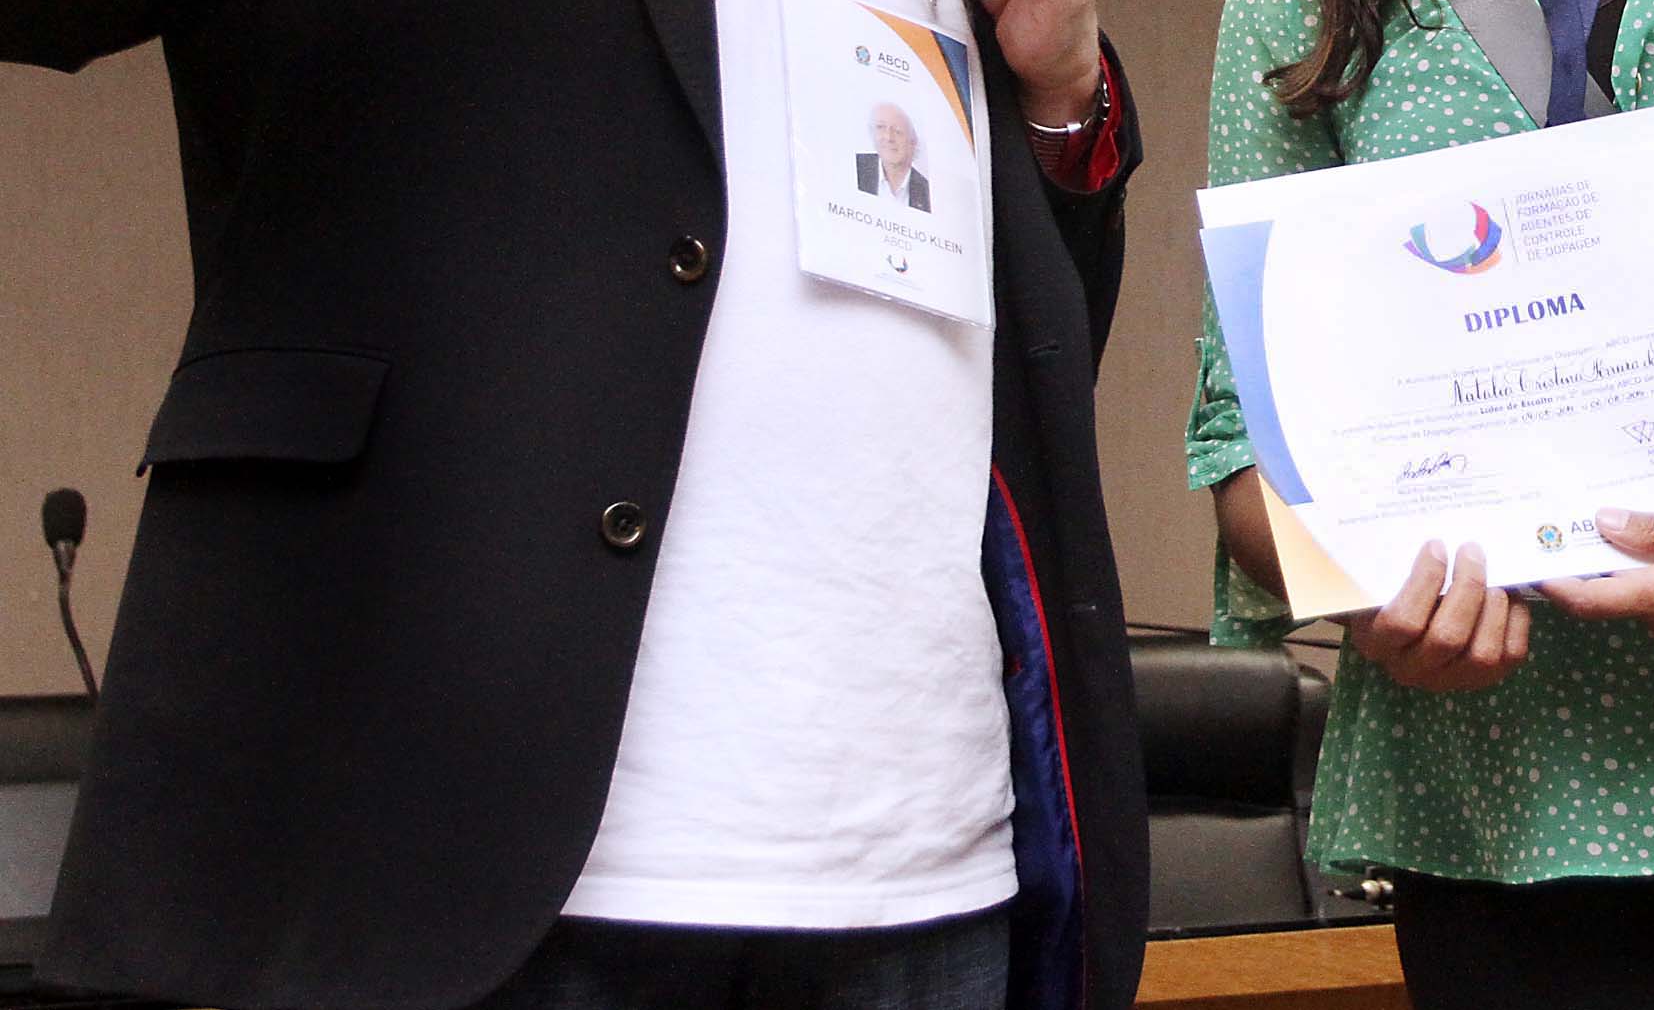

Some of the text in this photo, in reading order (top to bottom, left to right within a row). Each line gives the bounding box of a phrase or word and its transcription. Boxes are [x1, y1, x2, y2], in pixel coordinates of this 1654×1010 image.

[878, 52, 910, 71] ABCD
[828, 201, 872, 225] MARCO
[930, 234, 963, 256] KLEIN
[883, 234, 913, 251] ABCD
[1464, 292, 1586, 334] DIPLOMA
[1571, 519, 1595, 535] AB
